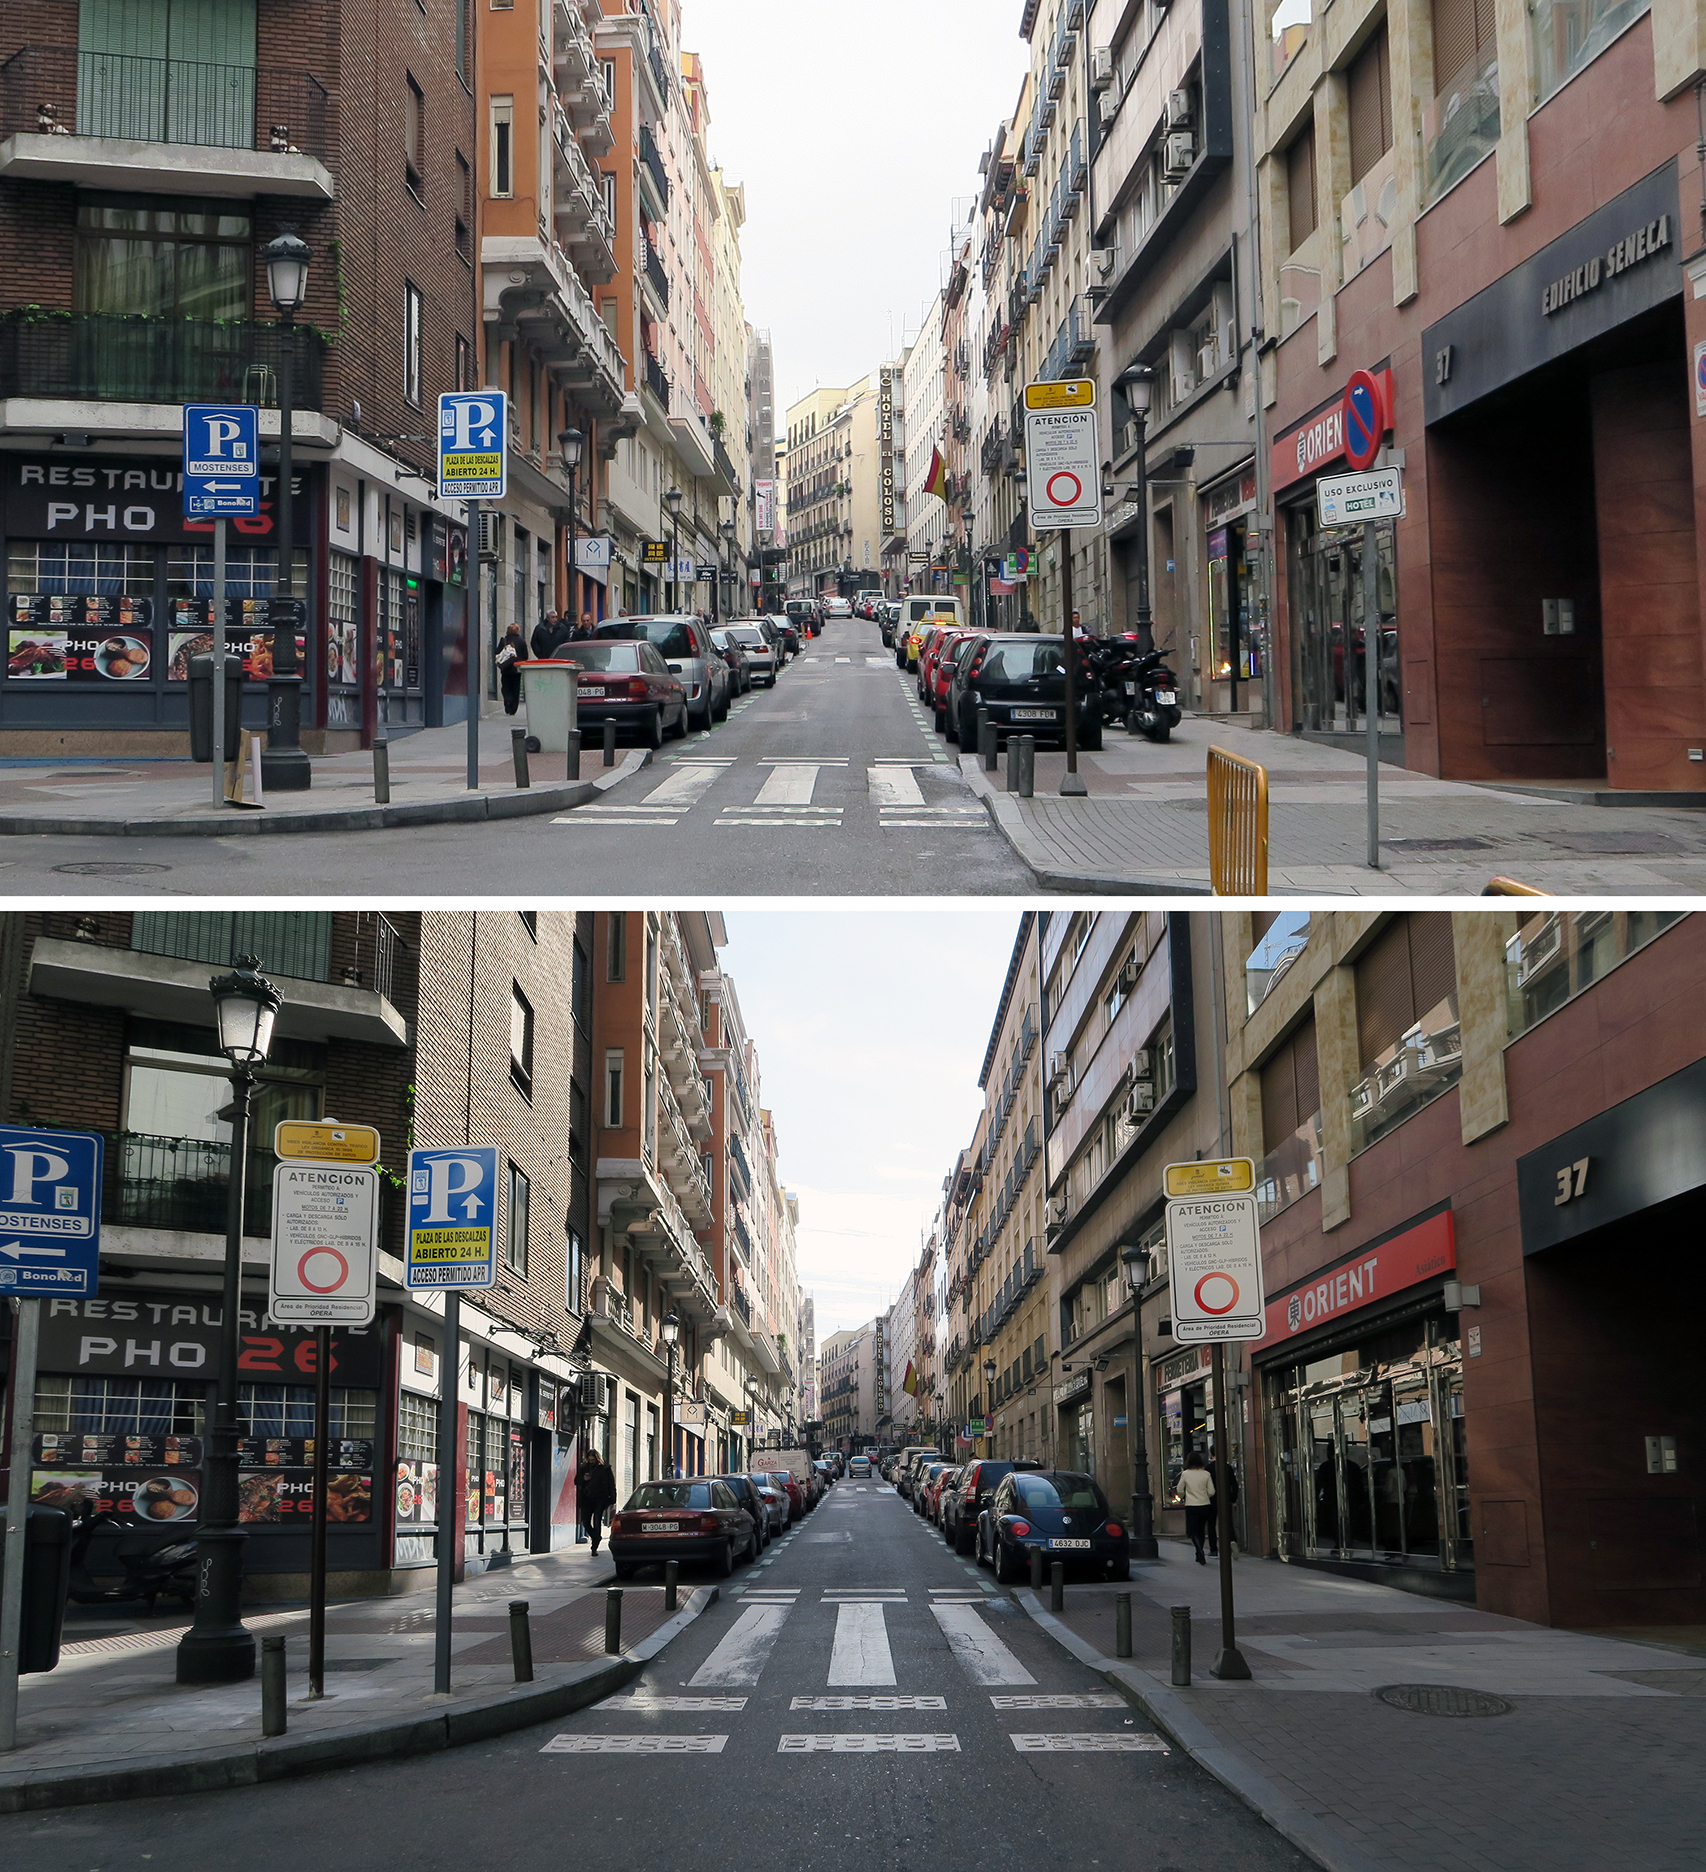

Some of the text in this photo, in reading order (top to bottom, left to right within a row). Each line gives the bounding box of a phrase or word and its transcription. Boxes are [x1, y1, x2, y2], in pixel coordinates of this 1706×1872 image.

[1542, 214, 1670, 316] EDIFICIO SENECA
[1436, 345, 1451, 385] 37
[881, 394, 891, 440] HOTEL
[1035, 414, 1087, 426] ATENCIÓN
[1307, 410, 1344, 464] ORIEN
[194, 463, 250, 472] MOSTENSES
[446, 455, 499, 465] PLAZA DE LAS DESCALZAS
[446, 468, 477, 476] ABIERTO
[490, 467, 498, 475] H.
[20, 464, 302, 496] RESTAUTE
[445, 482, 499, 494] ACCESO PERMITIDO APR
[1324, 479, 1393, 497] USO EXCLUSIVO
[883, 468, 892, 526] COLOSO
[47, 502, 155, 532] PHO
[62, 640, 100, 652] PHO
[63, 657, 96, 670] 26
[289, 1172, 365, 1186] ATENCIÓN
[1555, 1157, 1590, 1206] 37
[1179, 1201, 1245, 1216] ATENCIÓN
[0, 1214, 82, 1230] OSTENSES
[416, 1230, 487, 1244] PLAZA DE LAS DESCALZAS
[415, 1247, 484, 1259] ABIERTO 24 H.
[413, 1266, 486, 1283] ACCESO PERMITIDO APR
[1304, 1257, 1378, 1322] ORIENT
[50, 1299, 369, 1335] RESTAUR
[80, 1336, 339, 1373] PHO 26
[96, 1480, 140, 1493] PHO
[96, 1499, 135, 1512] 26
[1075, 1540, 1089, 1548] DJC
